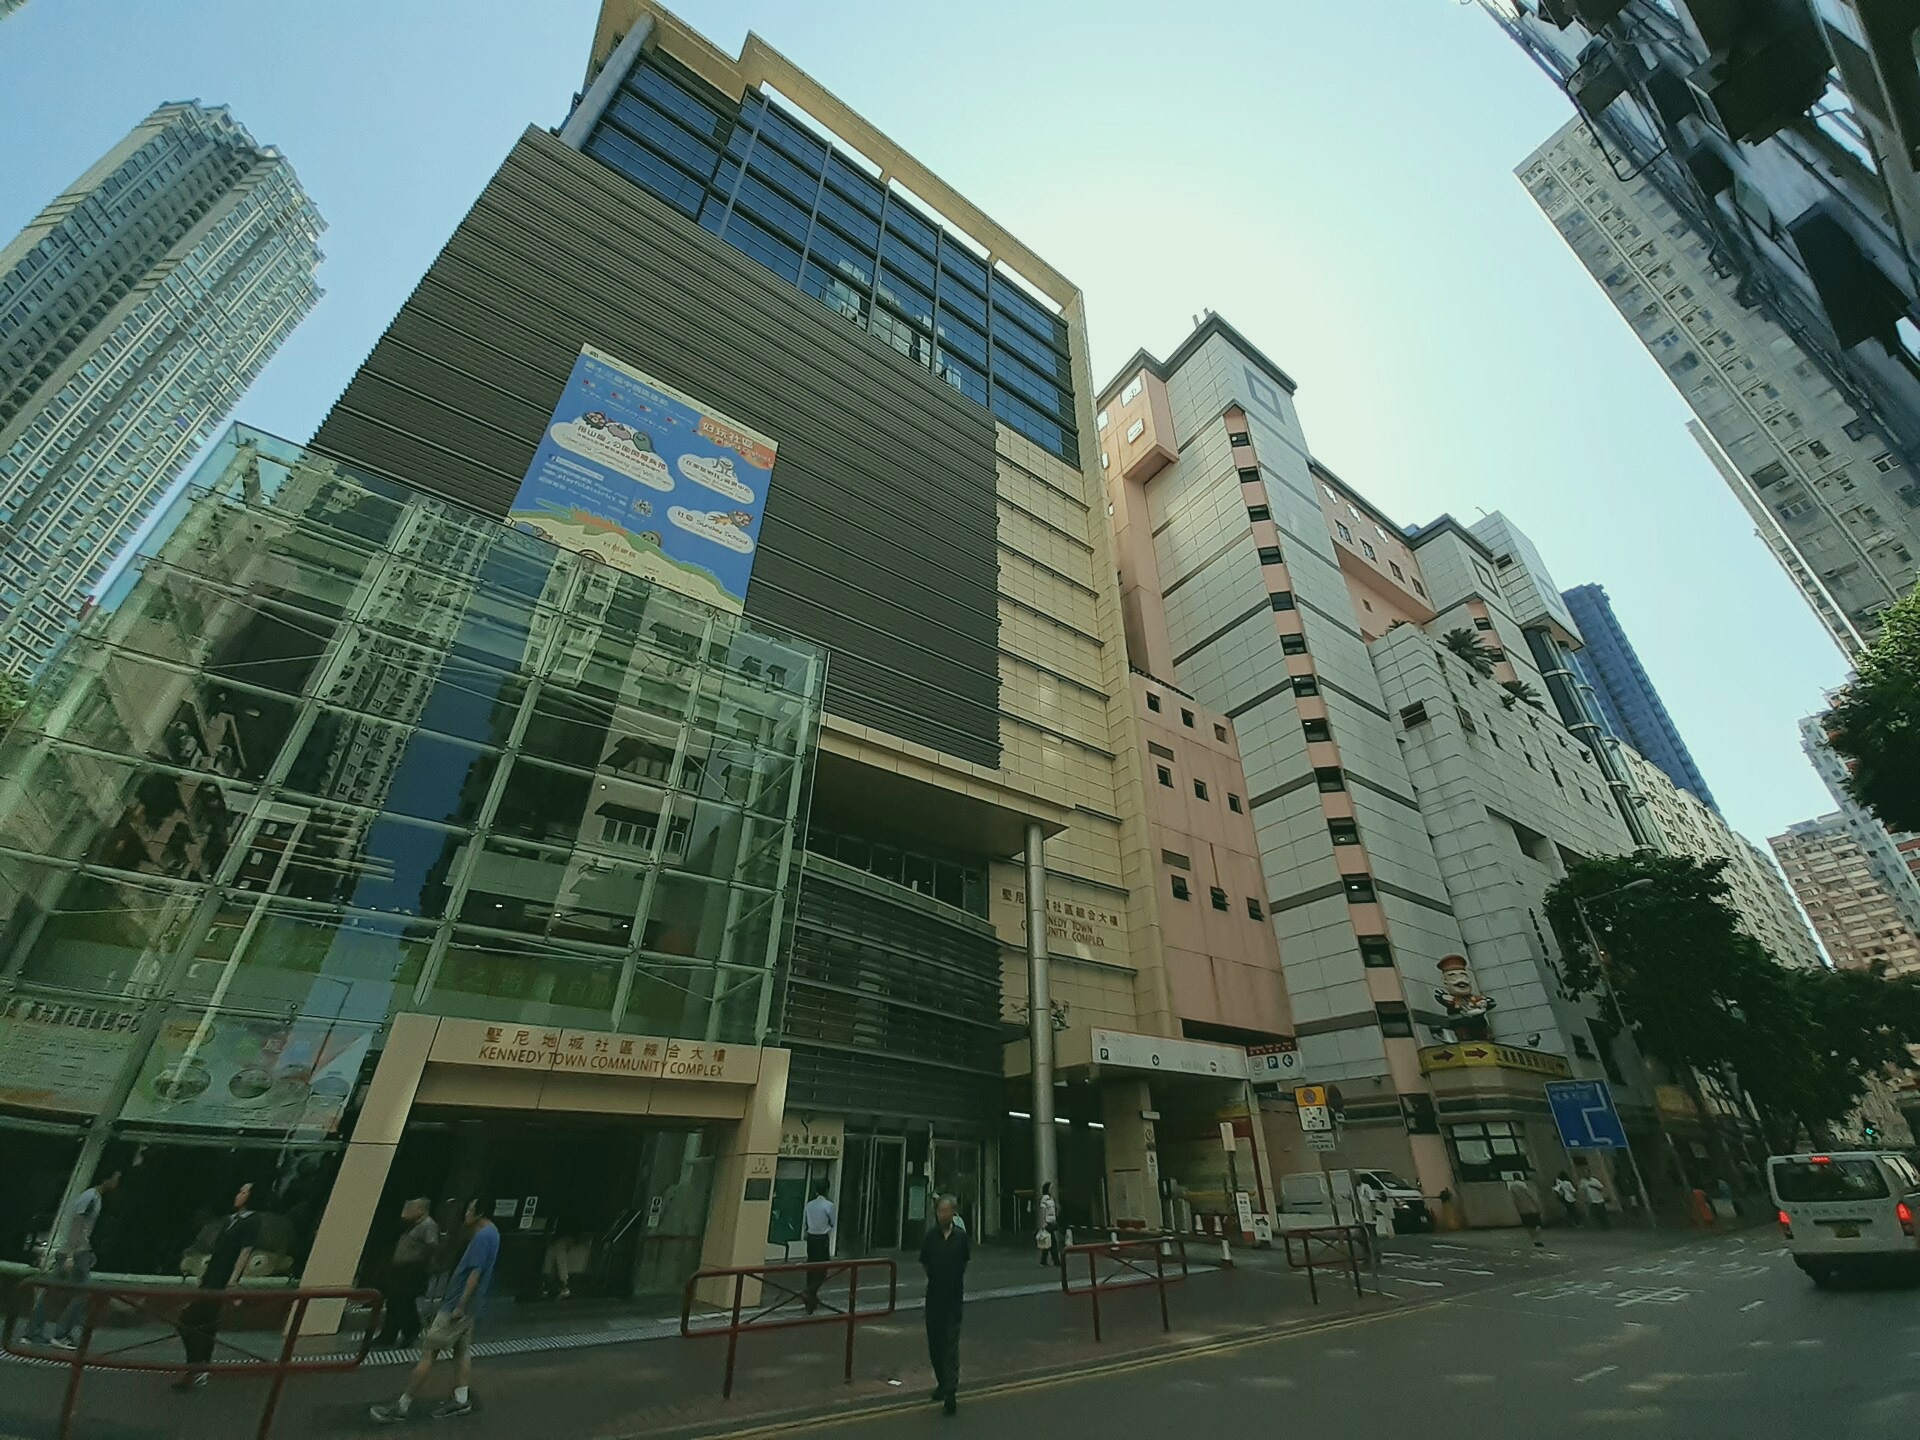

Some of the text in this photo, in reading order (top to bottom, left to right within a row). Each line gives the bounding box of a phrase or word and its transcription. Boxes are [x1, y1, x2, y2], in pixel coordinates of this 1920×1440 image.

[1003, 888, 1118, 927] 堅尼社區綜合大樓
[1071, 920, 1093, 935] TOWN
[1072, 931, 1105, 948] COMPLEX
[478, 1046, 724, 1077] KENNEDY TOWN COMMUNITY COMPLEX
